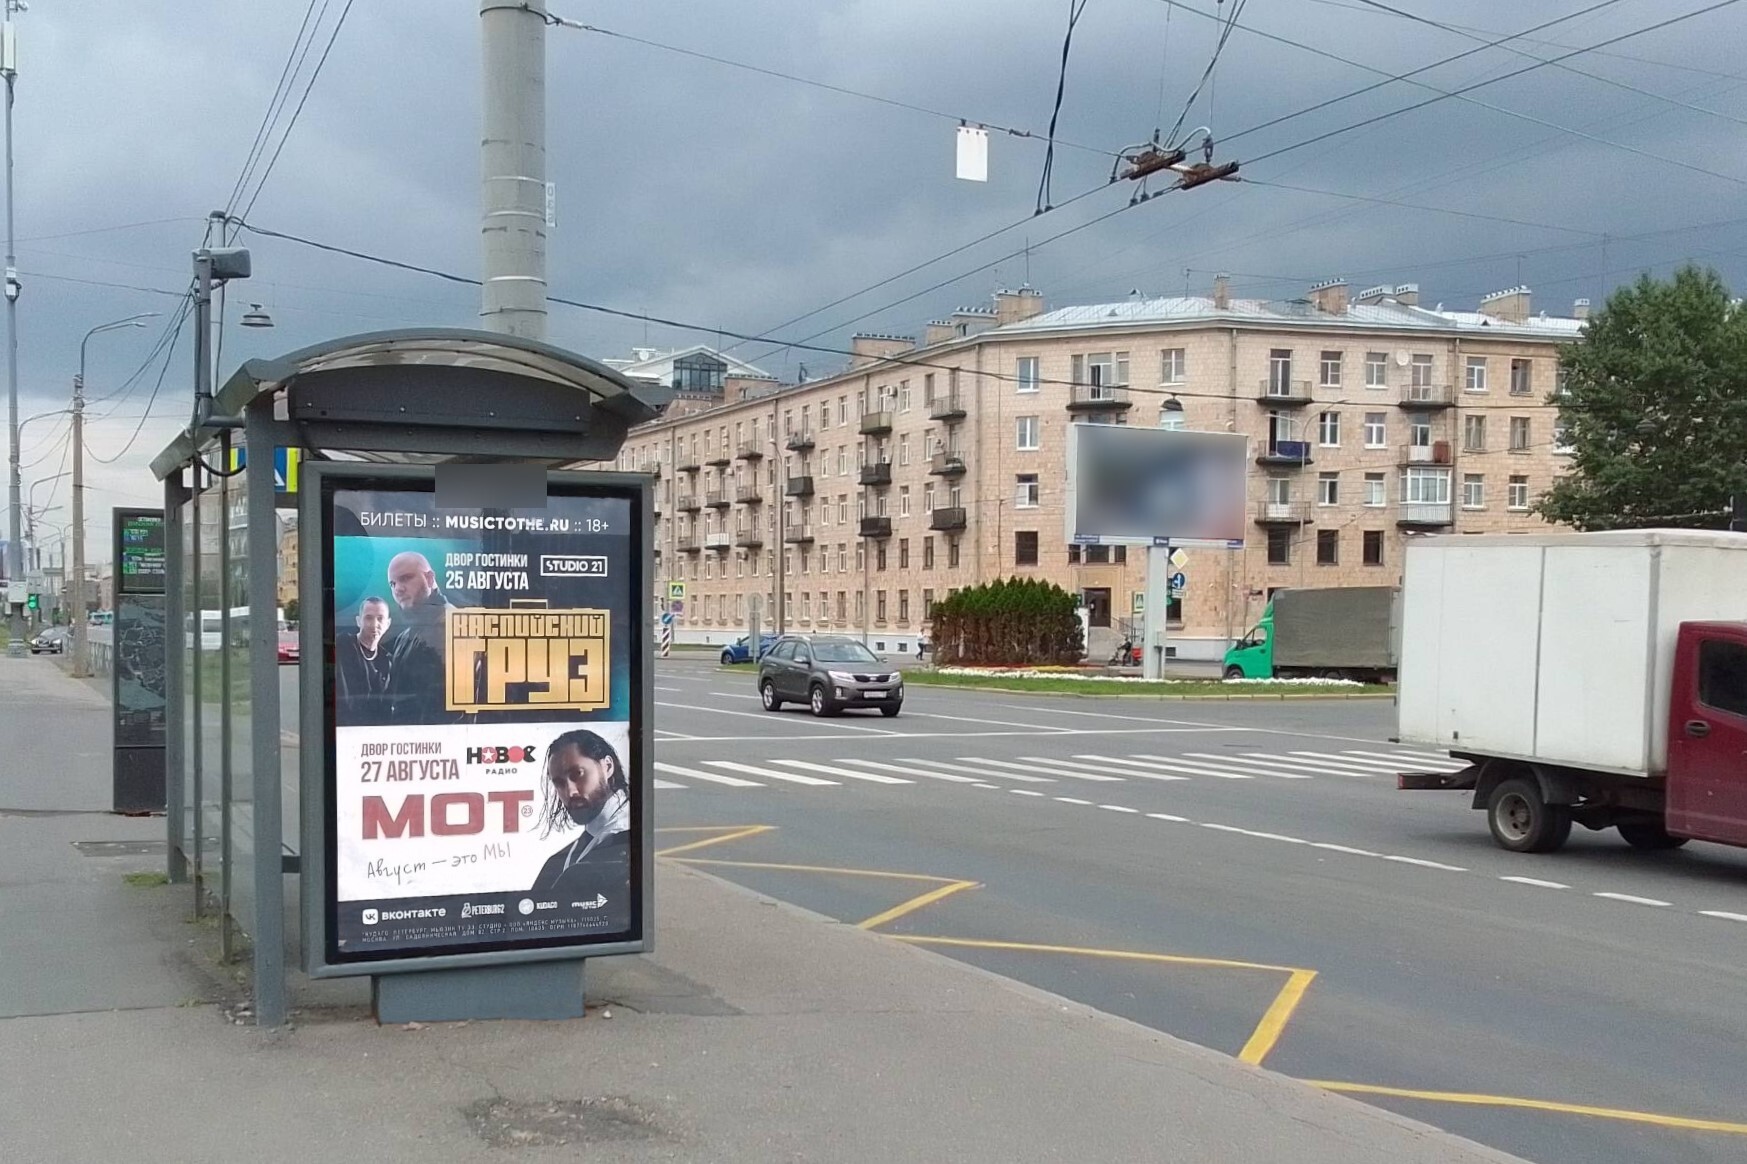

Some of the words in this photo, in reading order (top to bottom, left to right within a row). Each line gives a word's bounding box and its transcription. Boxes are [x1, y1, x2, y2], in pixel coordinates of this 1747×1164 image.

[360, 512, 427, 527] БИЛЕТЫ
[445, 516, 570, 532] MUSICTOTHE.RU
[586, 519, 609, 532] 18+
[445, 553, 473, 568] ДВОР
[475, 553, 528, 568] ГОСТИНКИ
[545, 561, 588, 573] STUDIO
[591, 561, 603, 573] 21
[445, 571, 464, 590] 25
[467, 571, 529, 590] АВГУСТА
[454, 613, 604, 637] КАСПИЙСКИЙ
[453, 638, 603, 704] ГРУЗ
[361, 744, 389, 758] ДВОР
[391, 742, 442, 756] ГОСТИНКИ
[361, 761, 381, 783] 27
[386, 759, 459, 782] АВГУСТА
[486, 767, 518, 775] РАДИО
[362, 790, 534, 840] МОТ
[367, 858, 426, 885] Август
[451, 852, 478, 868] это
[483, 843, 512, 861] МЫ
[381, 908, 446, 920] вконтакте
